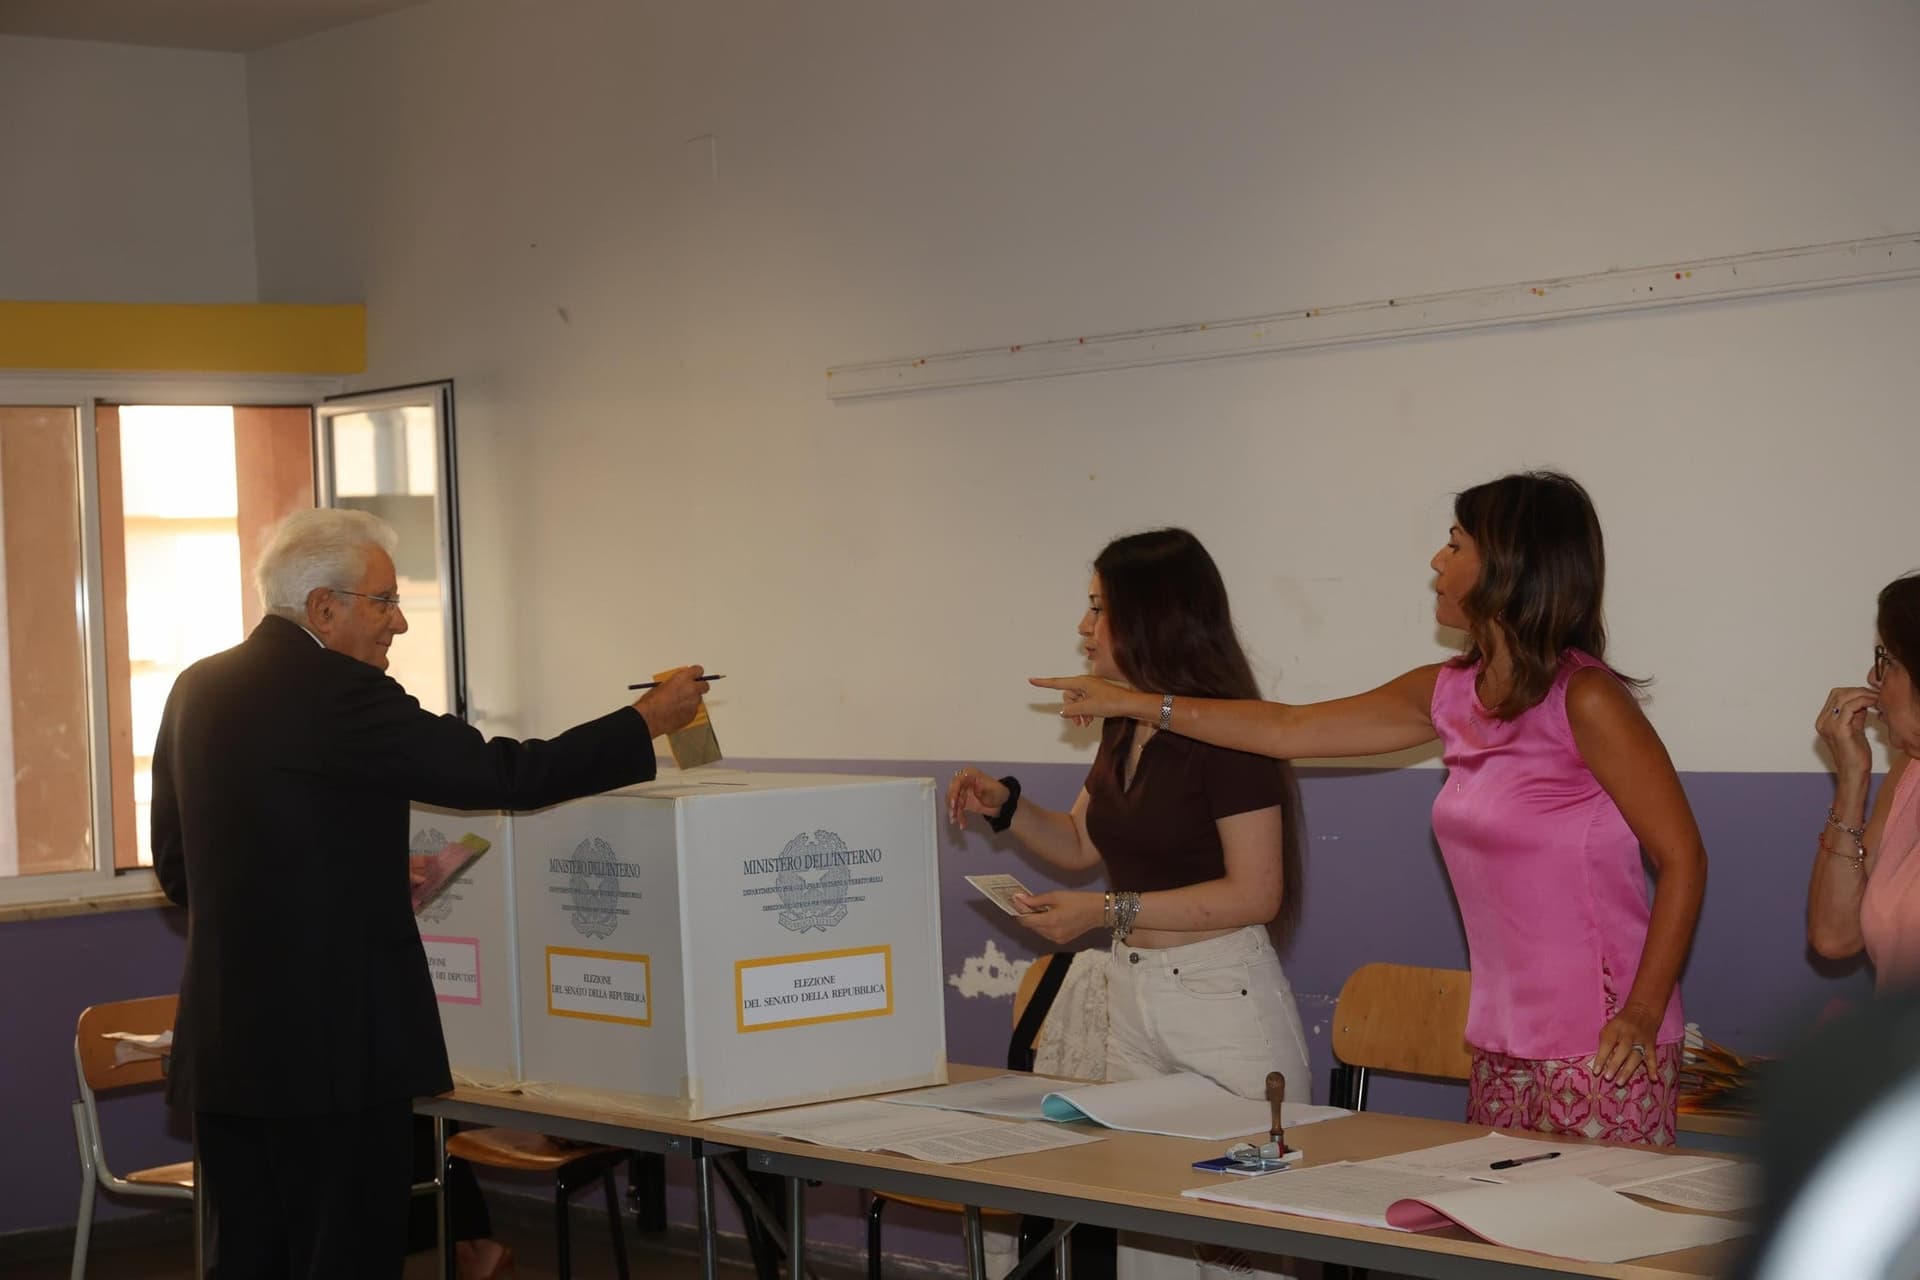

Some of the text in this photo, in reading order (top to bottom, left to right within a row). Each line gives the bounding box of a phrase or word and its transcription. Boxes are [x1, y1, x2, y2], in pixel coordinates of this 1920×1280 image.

[549, 858, 587, 874] MINISTERO
[743, 848, 882, 875] MINISTERO DELL'INTERNO
[583, 973, 612, 985] ELEZIONE
[794, 975, 836, 989] ELEZIONE
[551, 984, 646, 1003] DEL SENATO DELLA REPUBBLICA
[744, 984, 885, 1009] DEL SENATO DELLA REPUBBLICA
